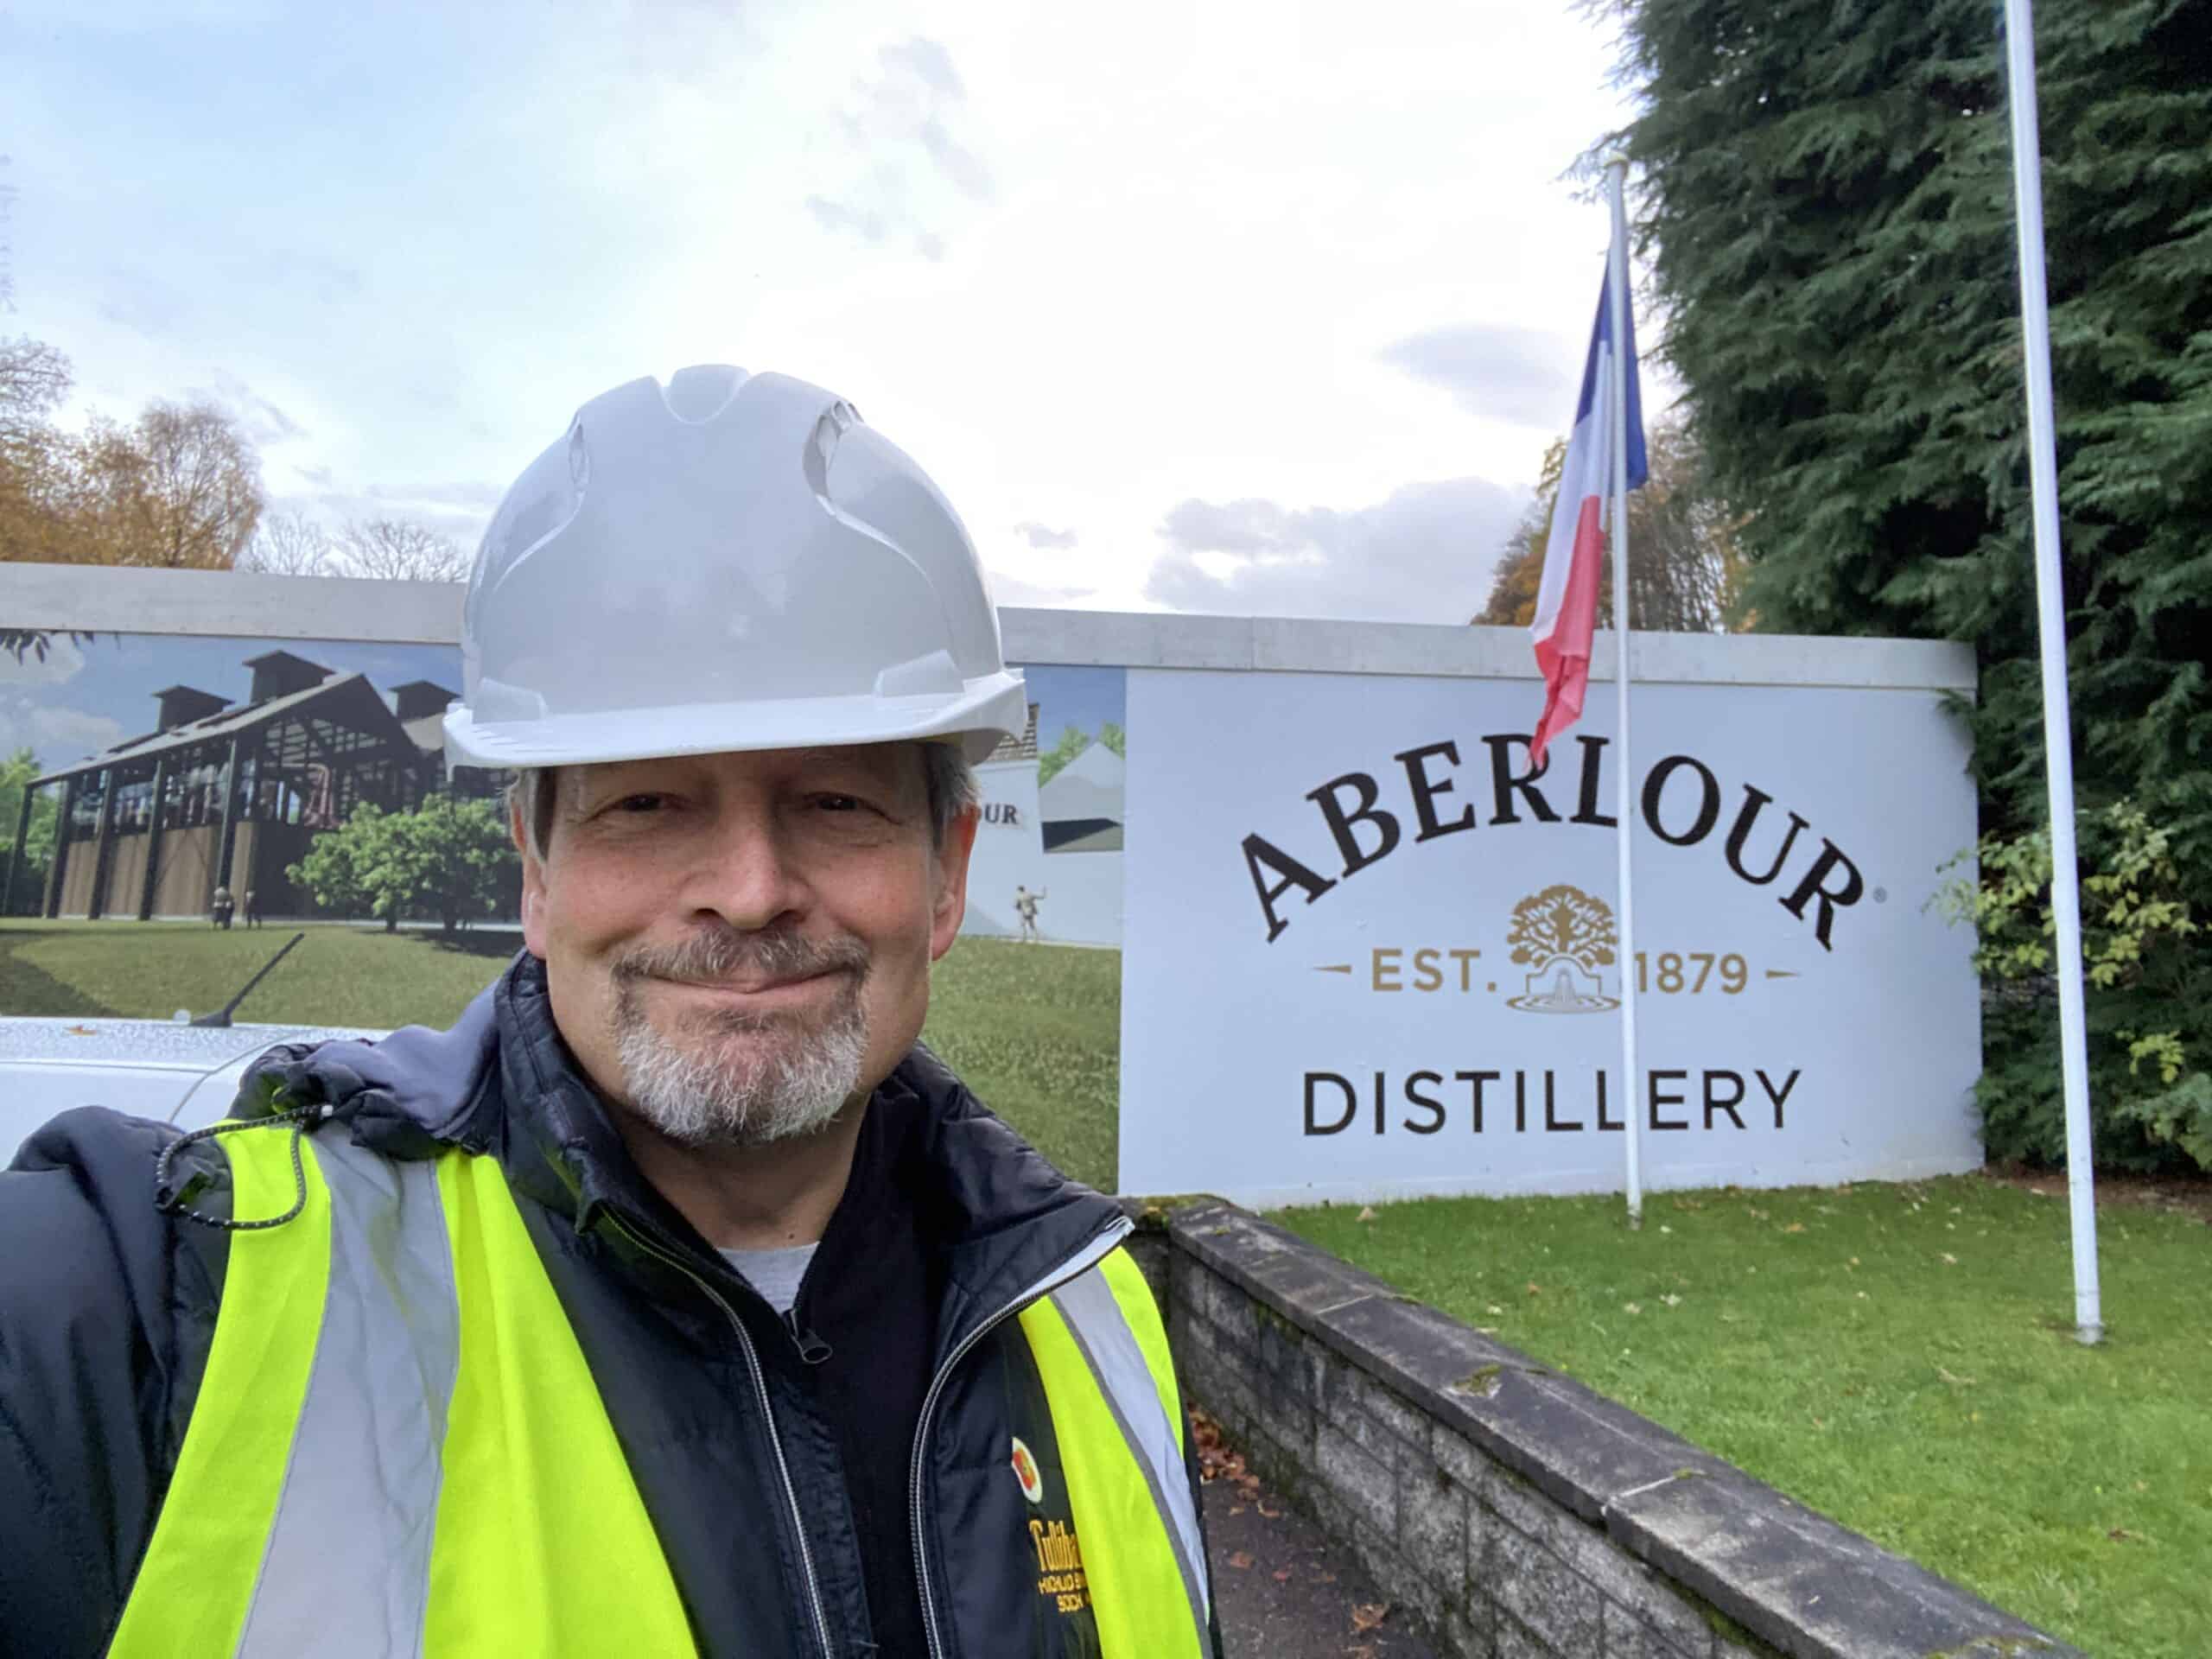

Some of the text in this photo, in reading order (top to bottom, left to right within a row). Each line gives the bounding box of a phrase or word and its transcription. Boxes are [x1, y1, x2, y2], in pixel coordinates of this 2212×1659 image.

[1242, 733, 1864, 951] ABERLOUR
[1371, 949, 1748, 995] EST. 1879
[1304, 1070, 1802, 1135] DISTILLERY
